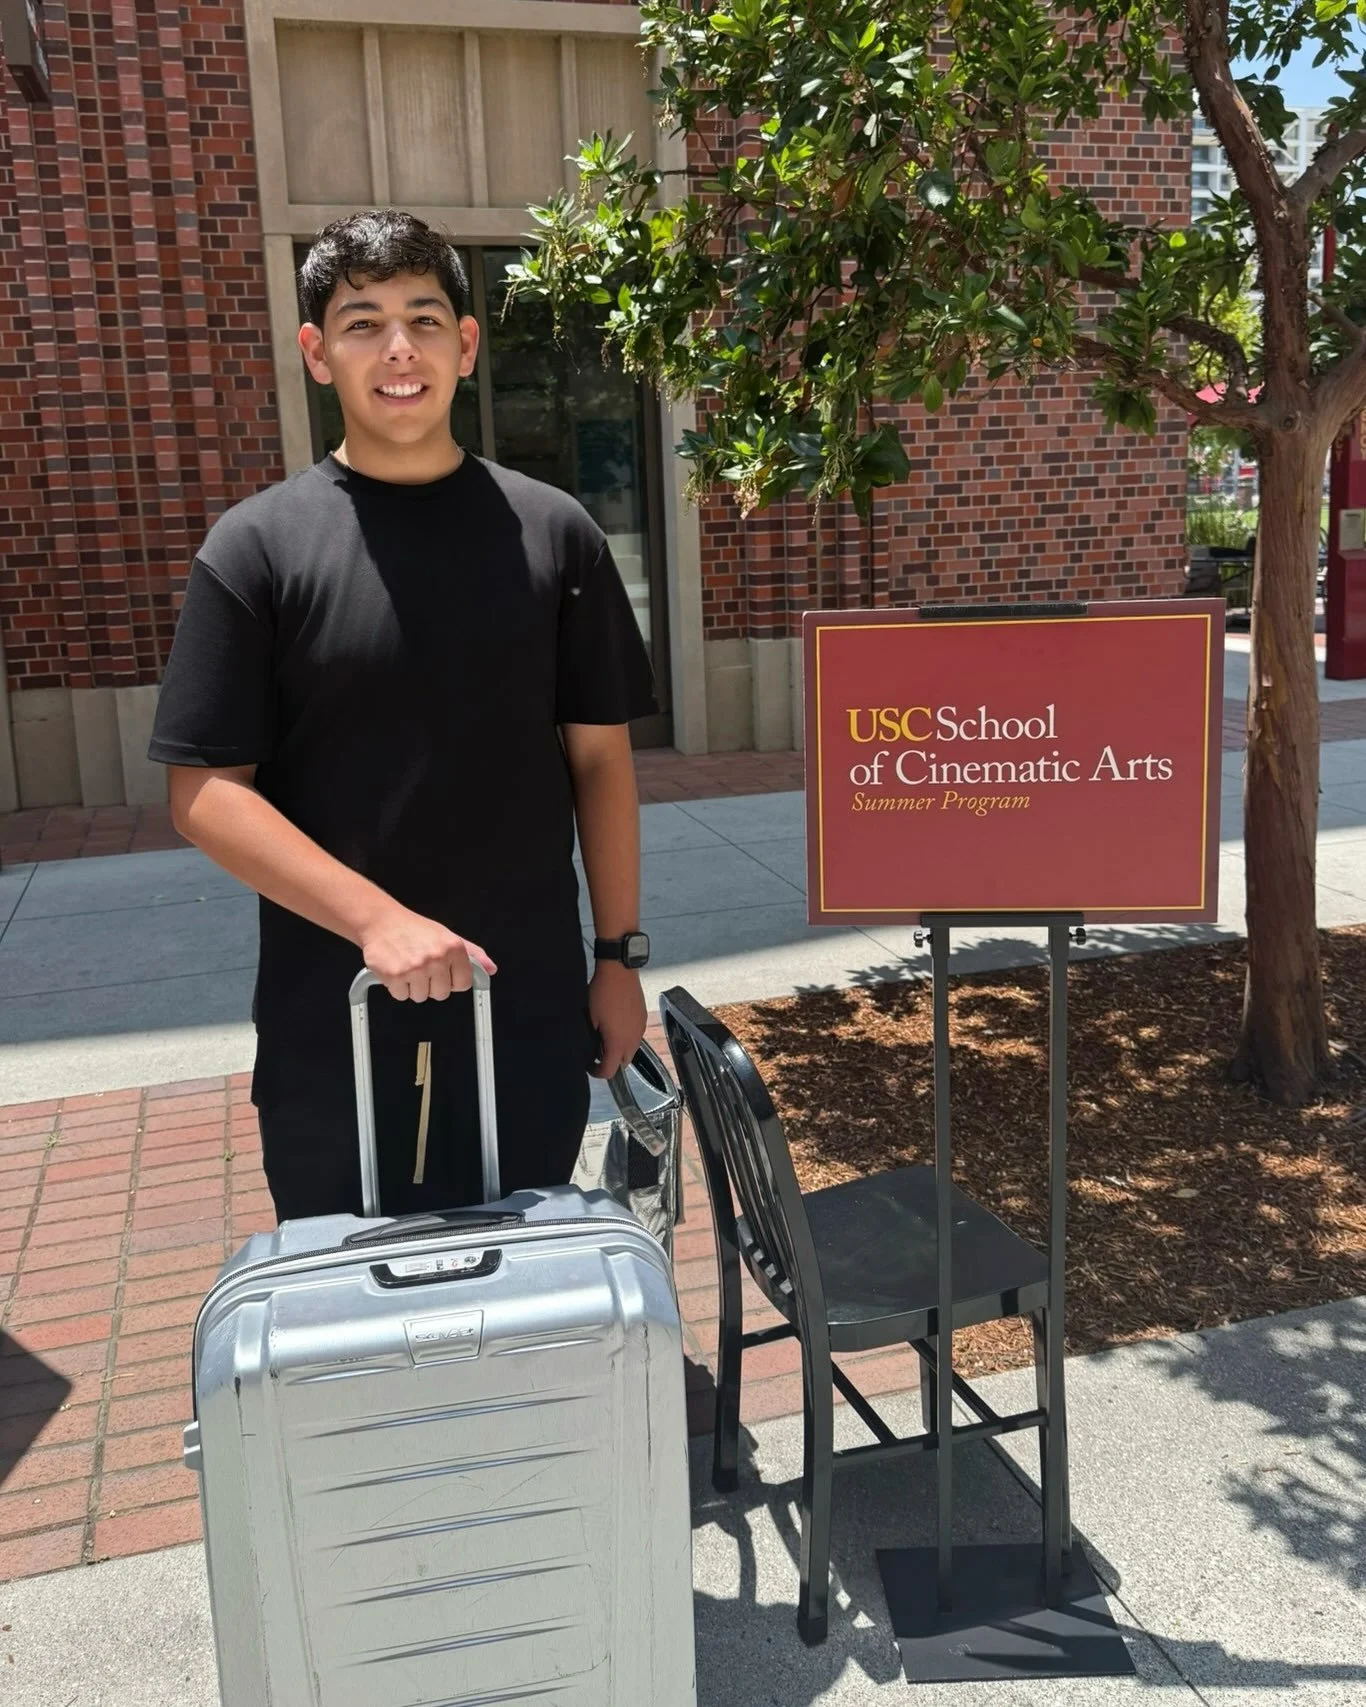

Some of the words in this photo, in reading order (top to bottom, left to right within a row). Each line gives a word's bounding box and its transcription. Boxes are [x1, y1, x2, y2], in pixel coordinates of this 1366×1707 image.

[846, 706, 933, 742] USC
[936, 704, 1058, 741] School
[850, 750, 890, 785] of
[895, 749, 1081, 785] Cinematic
[1088, 745, 1173, 781] Arts
[852, 791, 936, 811] Summer
[940, 790, 1030, 817] Program
